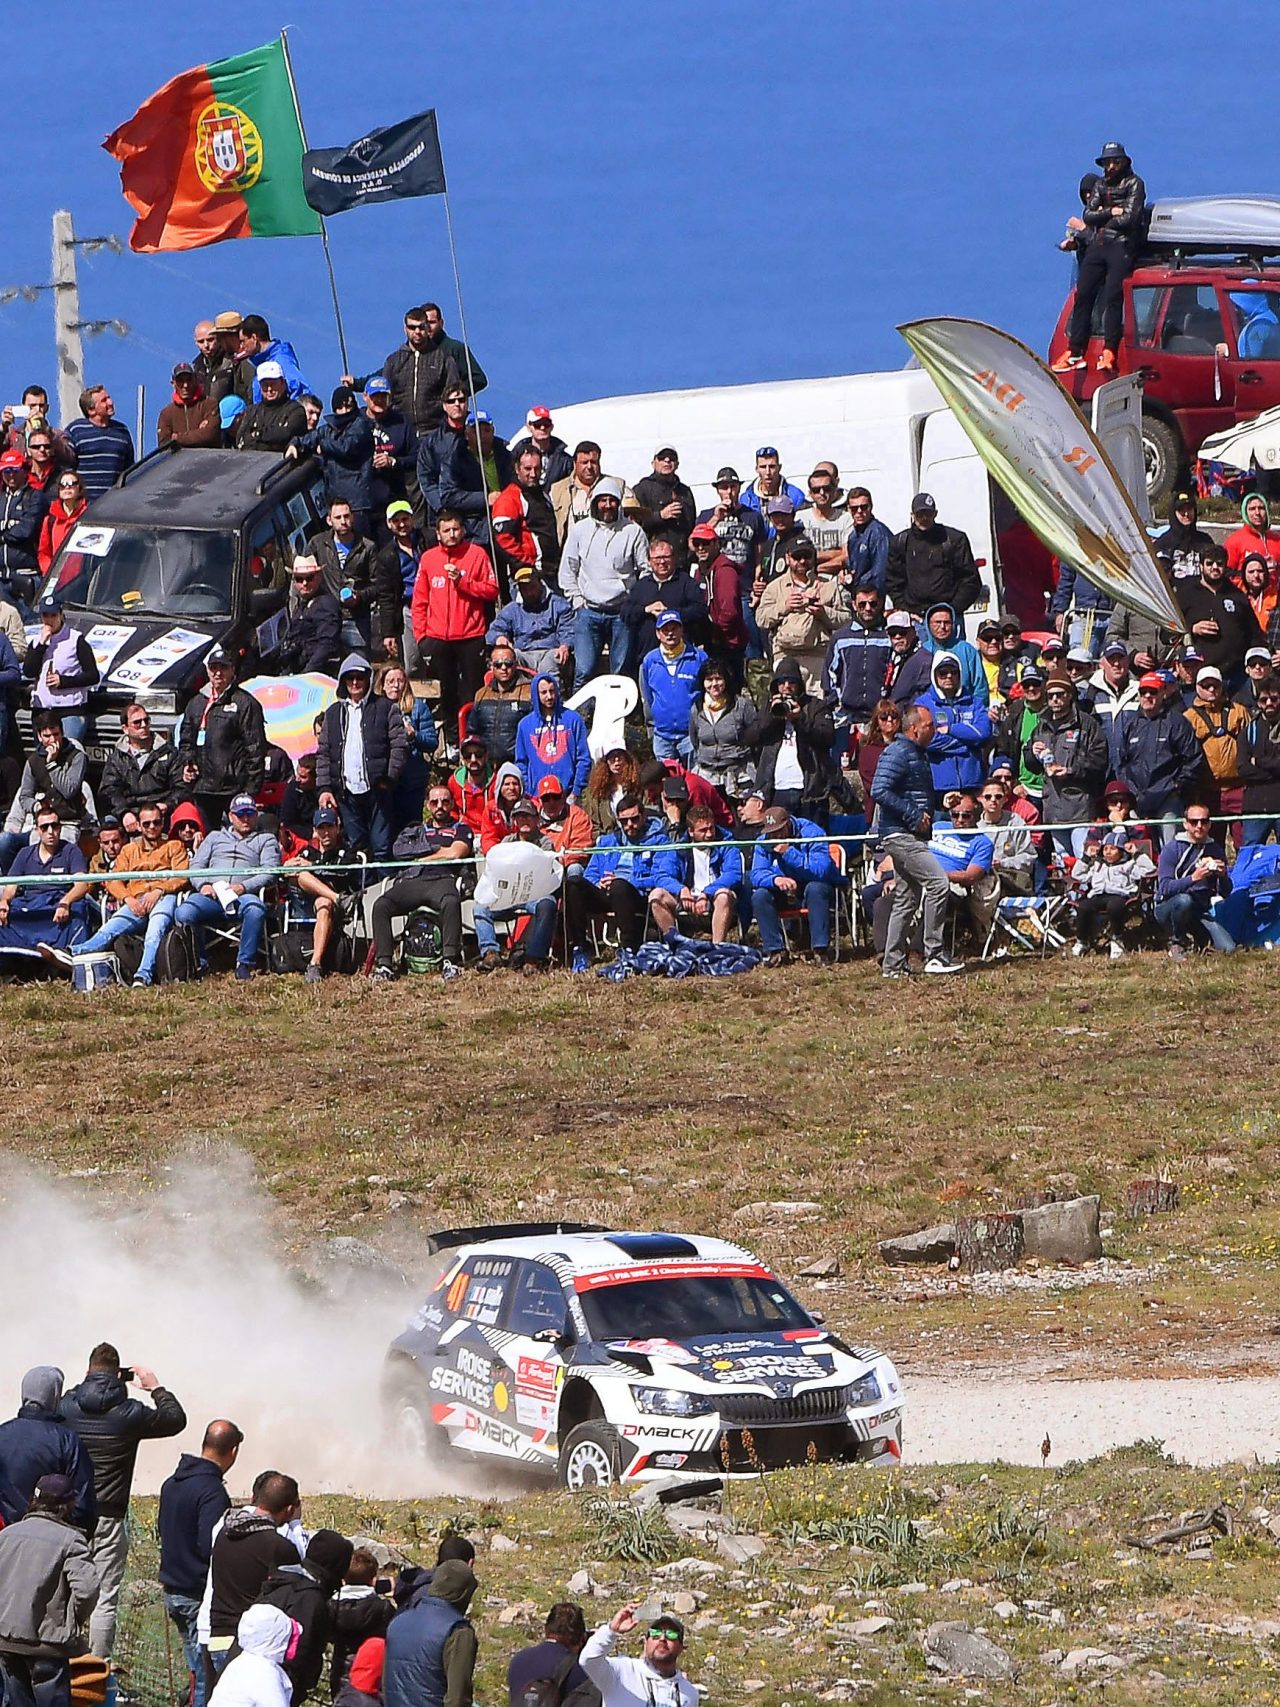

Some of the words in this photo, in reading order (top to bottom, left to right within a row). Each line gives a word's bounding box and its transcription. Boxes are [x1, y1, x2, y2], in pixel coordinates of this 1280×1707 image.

[116, 669, 142, 681] Q8
[447, 1271, 470, 1312] 41
[457, 1347, 492, 1383] IROISE
[715, 1365, 828, 1384] SERVICES
[737, 1355, 819, 1367] IROISE
[429, 1366, 491, 1408] SERVICES
